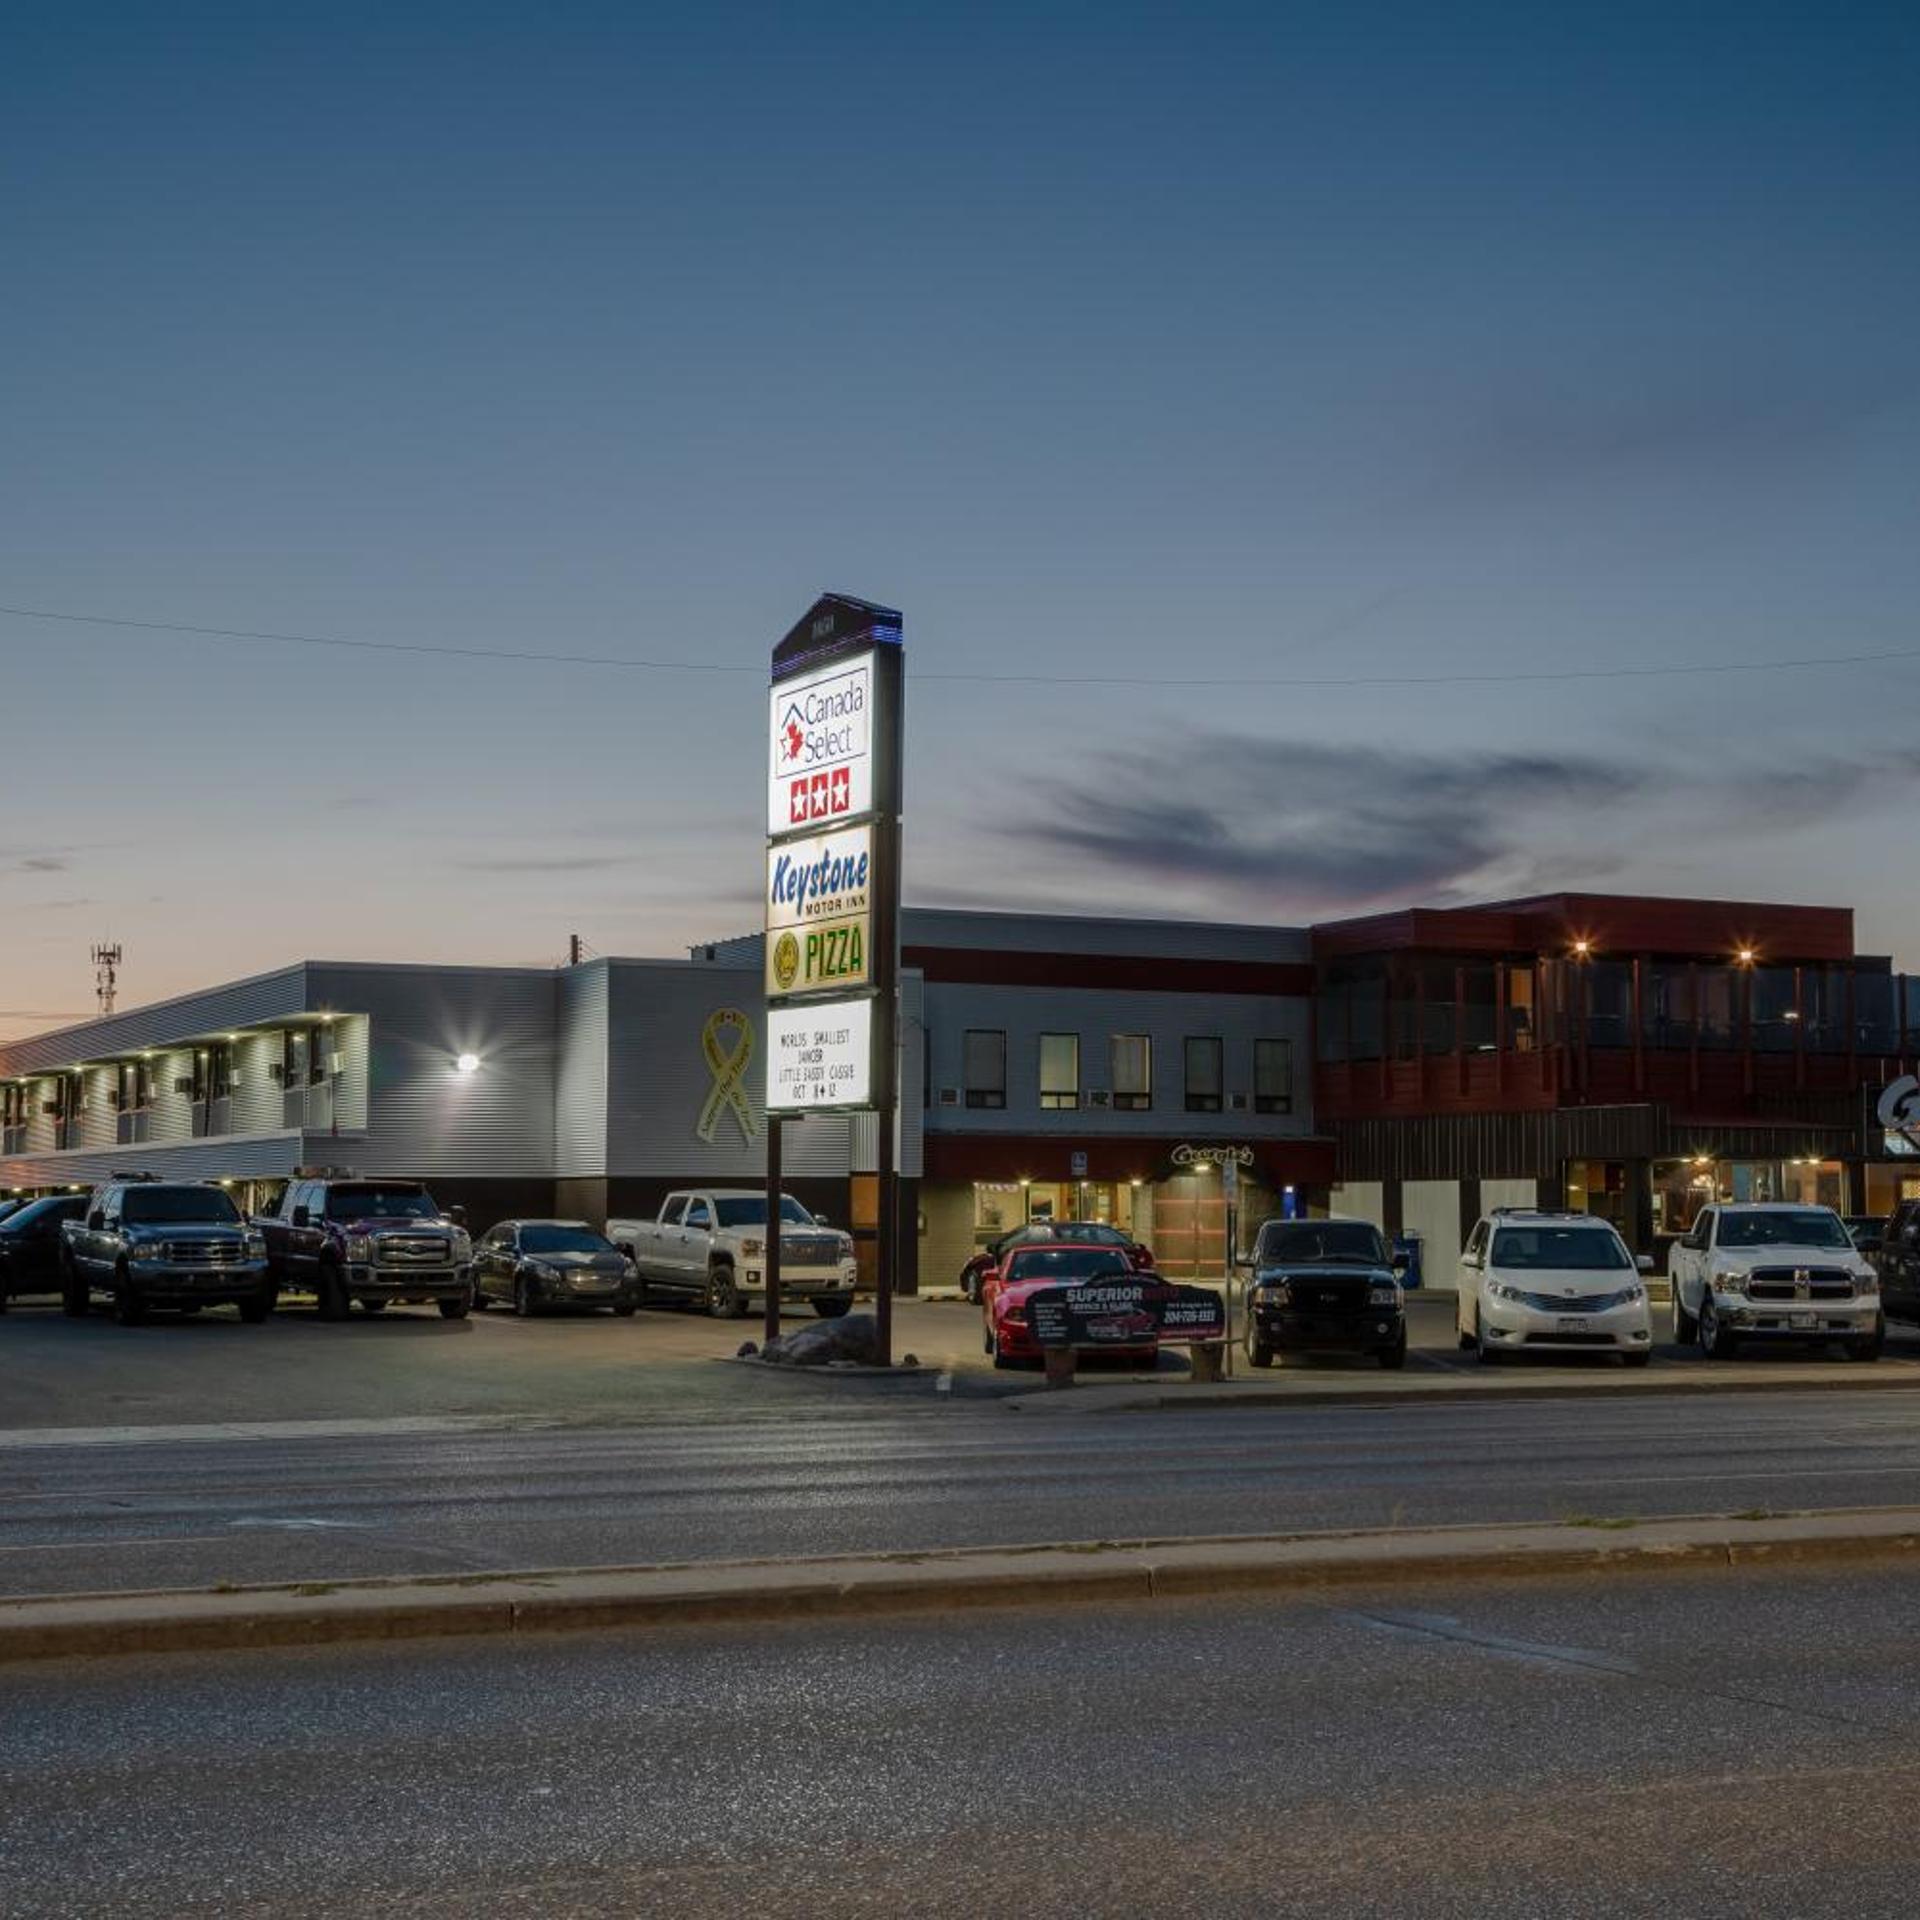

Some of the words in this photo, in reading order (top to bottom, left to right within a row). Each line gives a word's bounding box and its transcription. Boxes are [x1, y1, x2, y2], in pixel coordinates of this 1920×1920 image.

[804, 680, 863, 725] Canada
[804, 725, 852, 763] Select
[772, 847, 868, 917] Keystone
[806, 899, 841, 915] MOTOR
[846, 895, 865, 907] INN
[805, 924, 863, 980] PIZZA
[814, 1028, 850, 1046] SMALLEST
[1066, 1286, 1144, 1302] SUPERIOR
